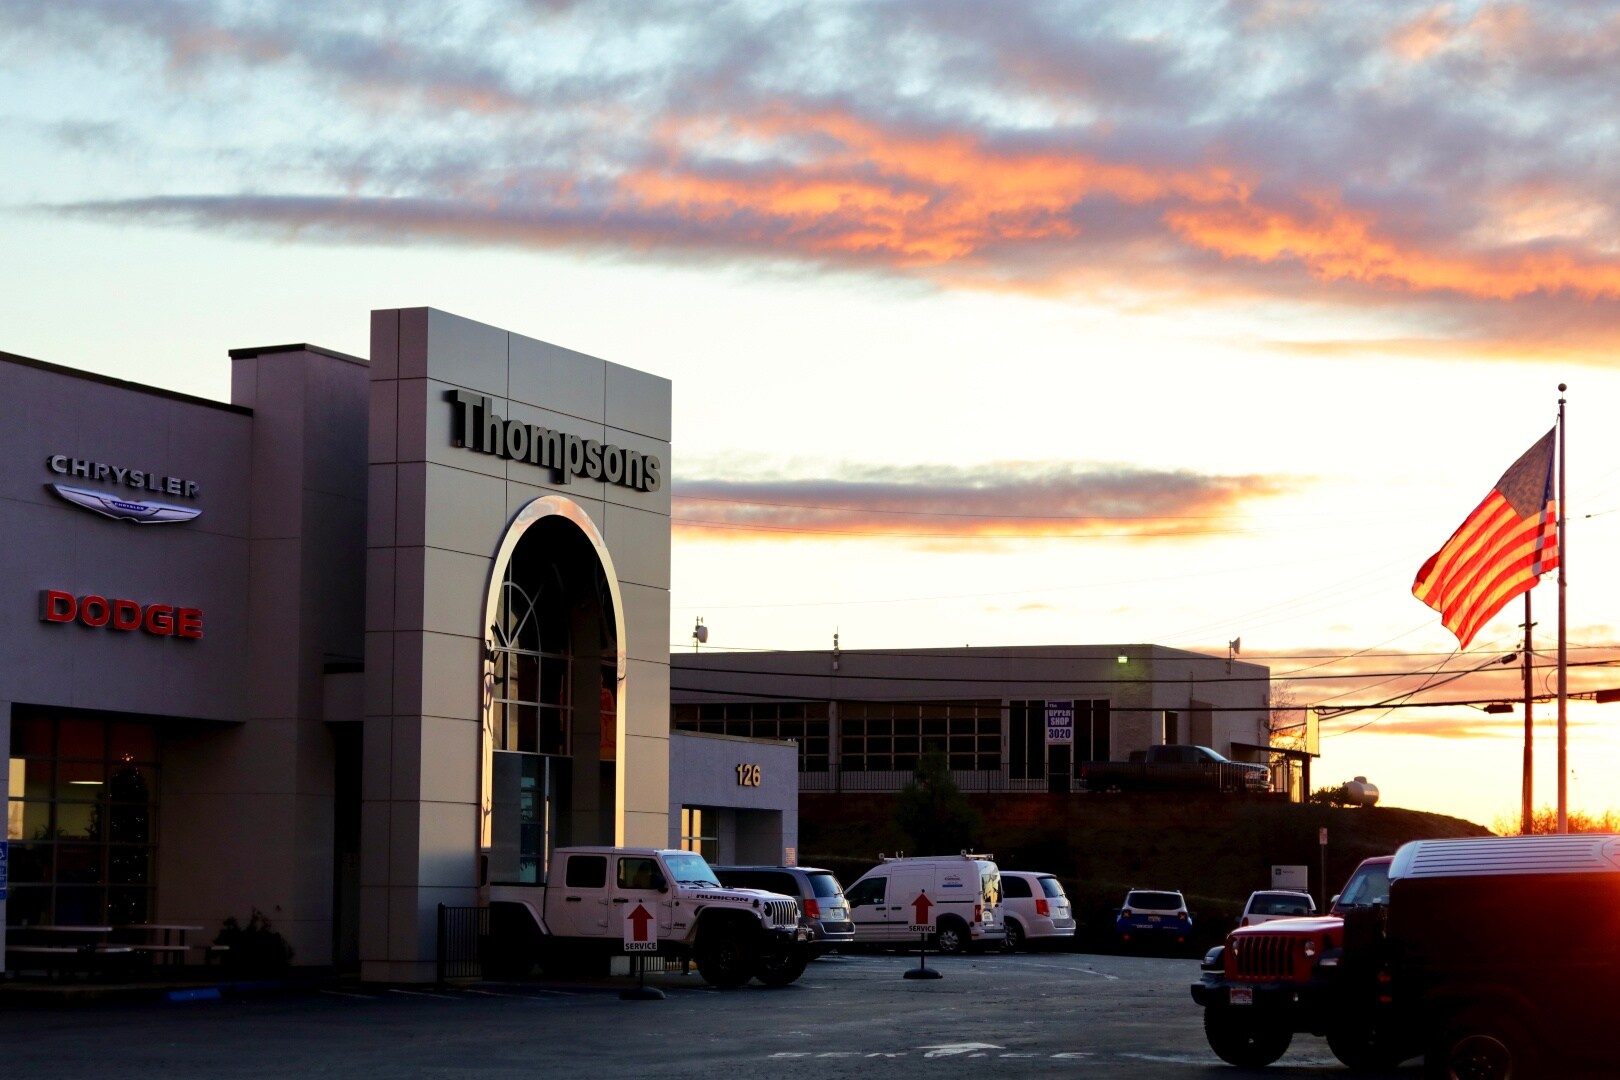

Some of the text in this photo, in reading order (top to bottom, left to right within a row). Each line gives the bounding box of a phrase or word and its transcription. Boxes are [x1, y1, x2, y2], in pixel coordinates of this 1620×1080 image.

[446, 389, 661, 492] Thompsons
[48, 454, 200, 497] CHRYSLER
[43, 589, 203, 639] DODGE
[1050, 716, 1070, 726] SHOP
[1048, 728, 1070, 738] 3020
[736, 763, 761, 787] 126
[696, 894, 749, 902] RUBICON
[625, 942, 657, 950] SERVICE
